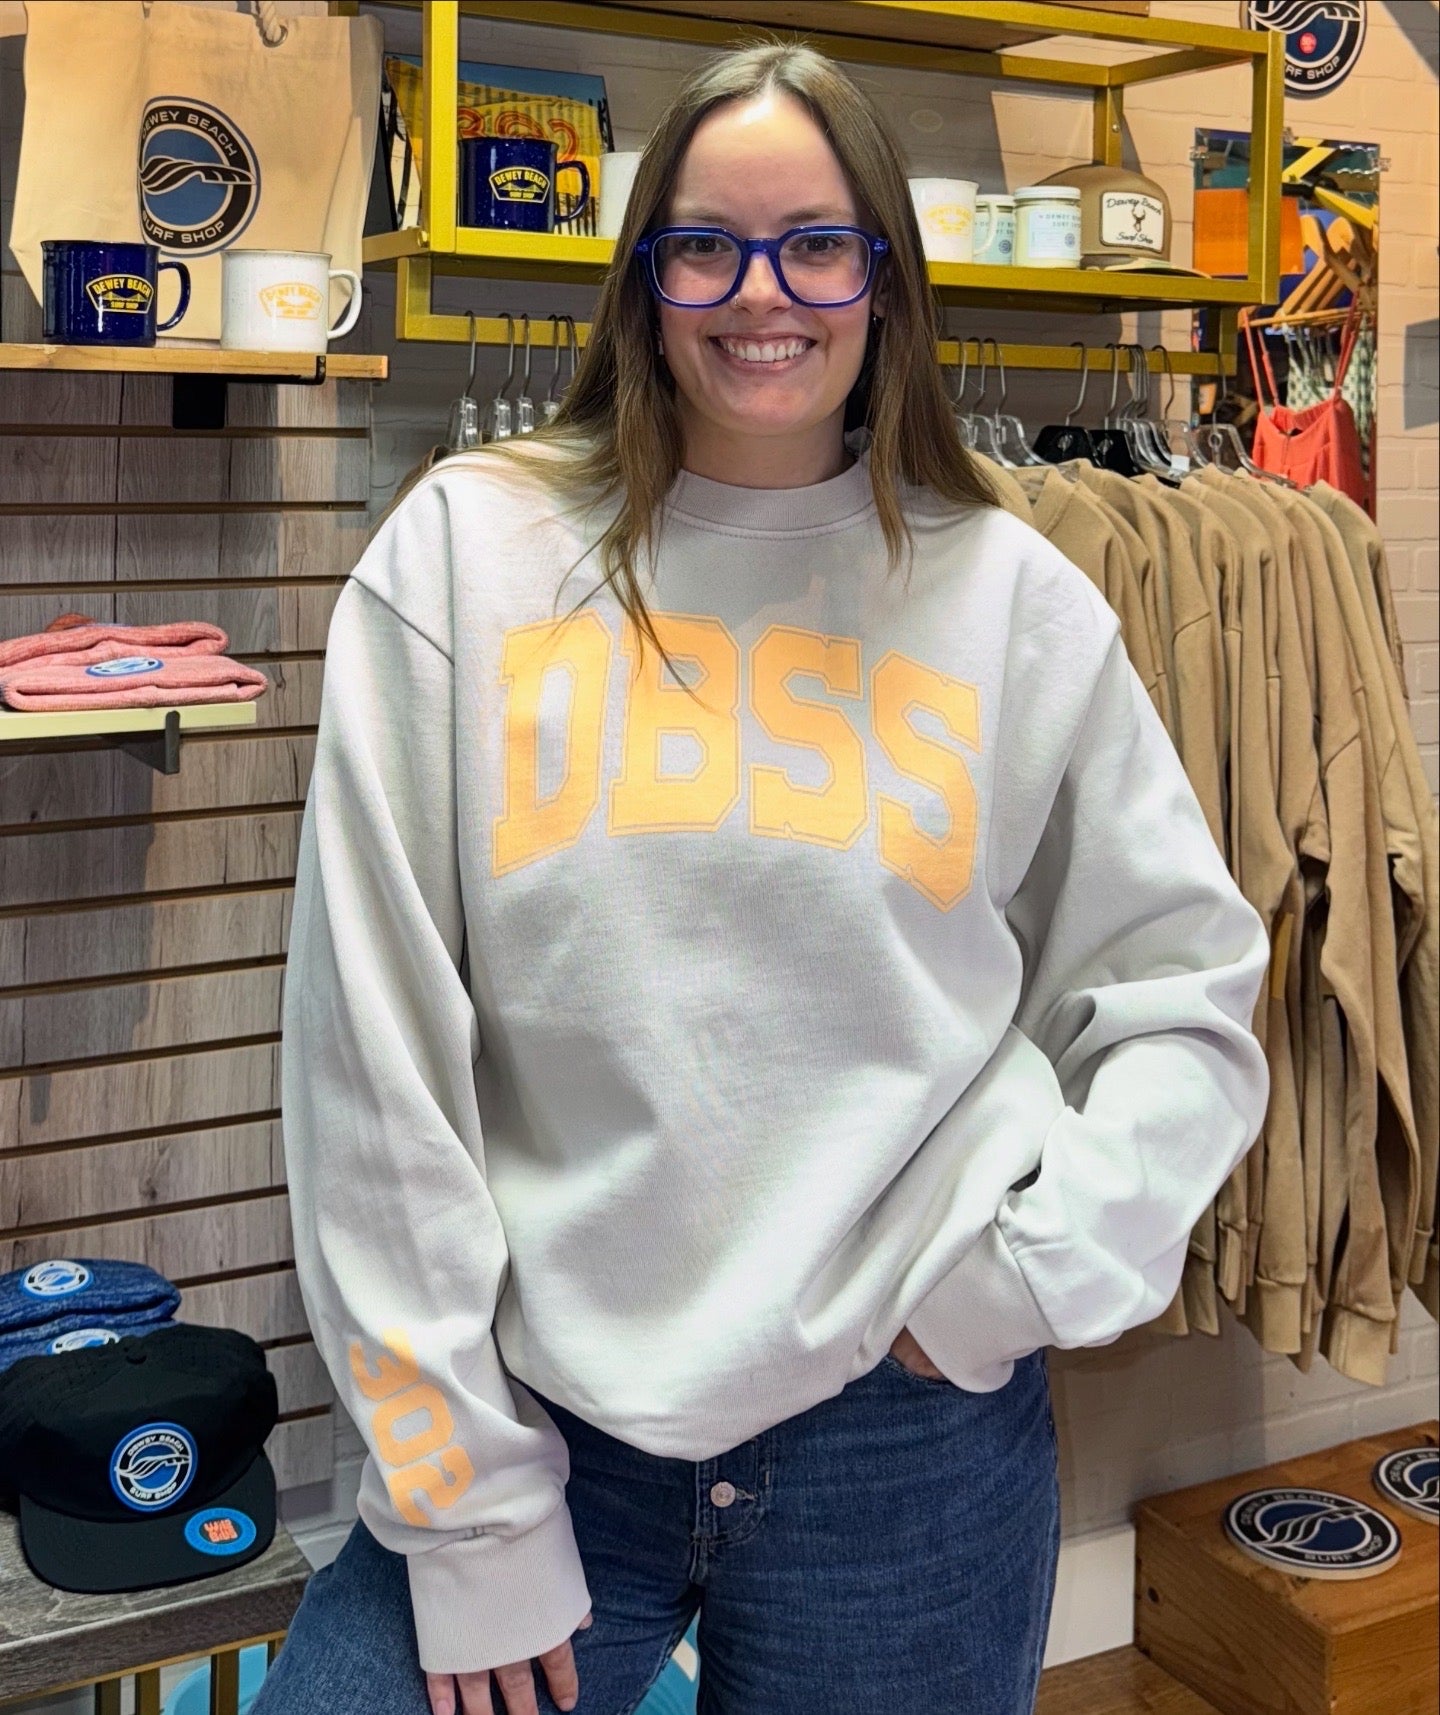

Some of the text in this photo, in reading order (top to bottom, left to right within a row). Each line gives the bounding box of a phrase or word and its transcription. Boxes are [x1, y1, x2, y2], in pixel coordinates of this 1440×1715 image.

[1306, 55, 1341, 80] SHOP
[187, 113, 238, 157] BEACH
[494, 170, 523, 186] DEWEY
[180, 220, 226, 244] SHOP
[92, 278, 152, 298] DEWEY BEACH
[491, 607, 983, 914] DBSS
[349, 1326, 476, 1528] 302
